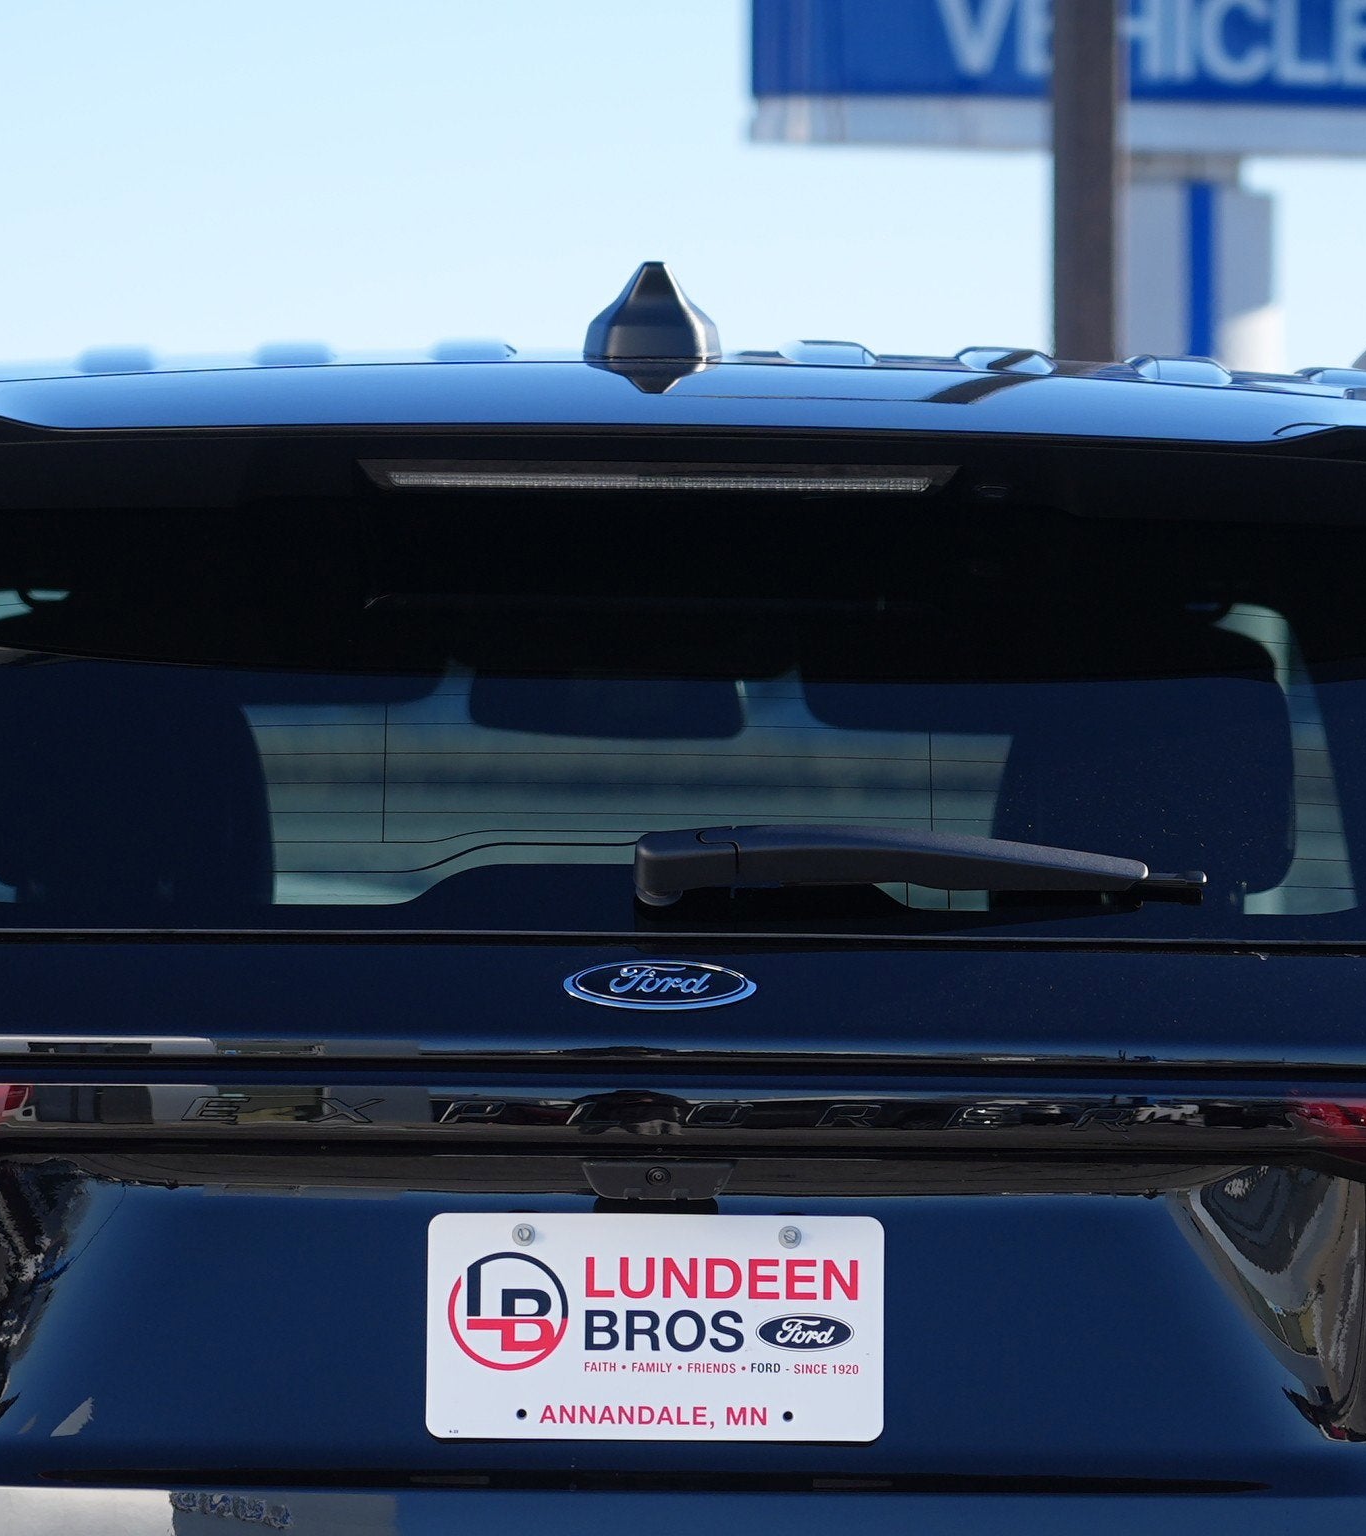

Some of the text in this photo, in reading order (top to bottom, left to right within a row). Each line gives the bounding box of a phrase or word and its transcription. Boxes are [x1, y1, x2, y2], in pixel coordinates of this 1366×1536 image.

[609, 965, 712, 993] Ford
[584, 1256, 859, 1301] LUNDEEN
[584, 1309, 836, 1353] BROS Ford
[584, 1361, 860, 1375] FAITH FAMILY FRIENDS FORD SINCE 1920
[539, 1405, 768, 1429] ANNANDALE, MN
